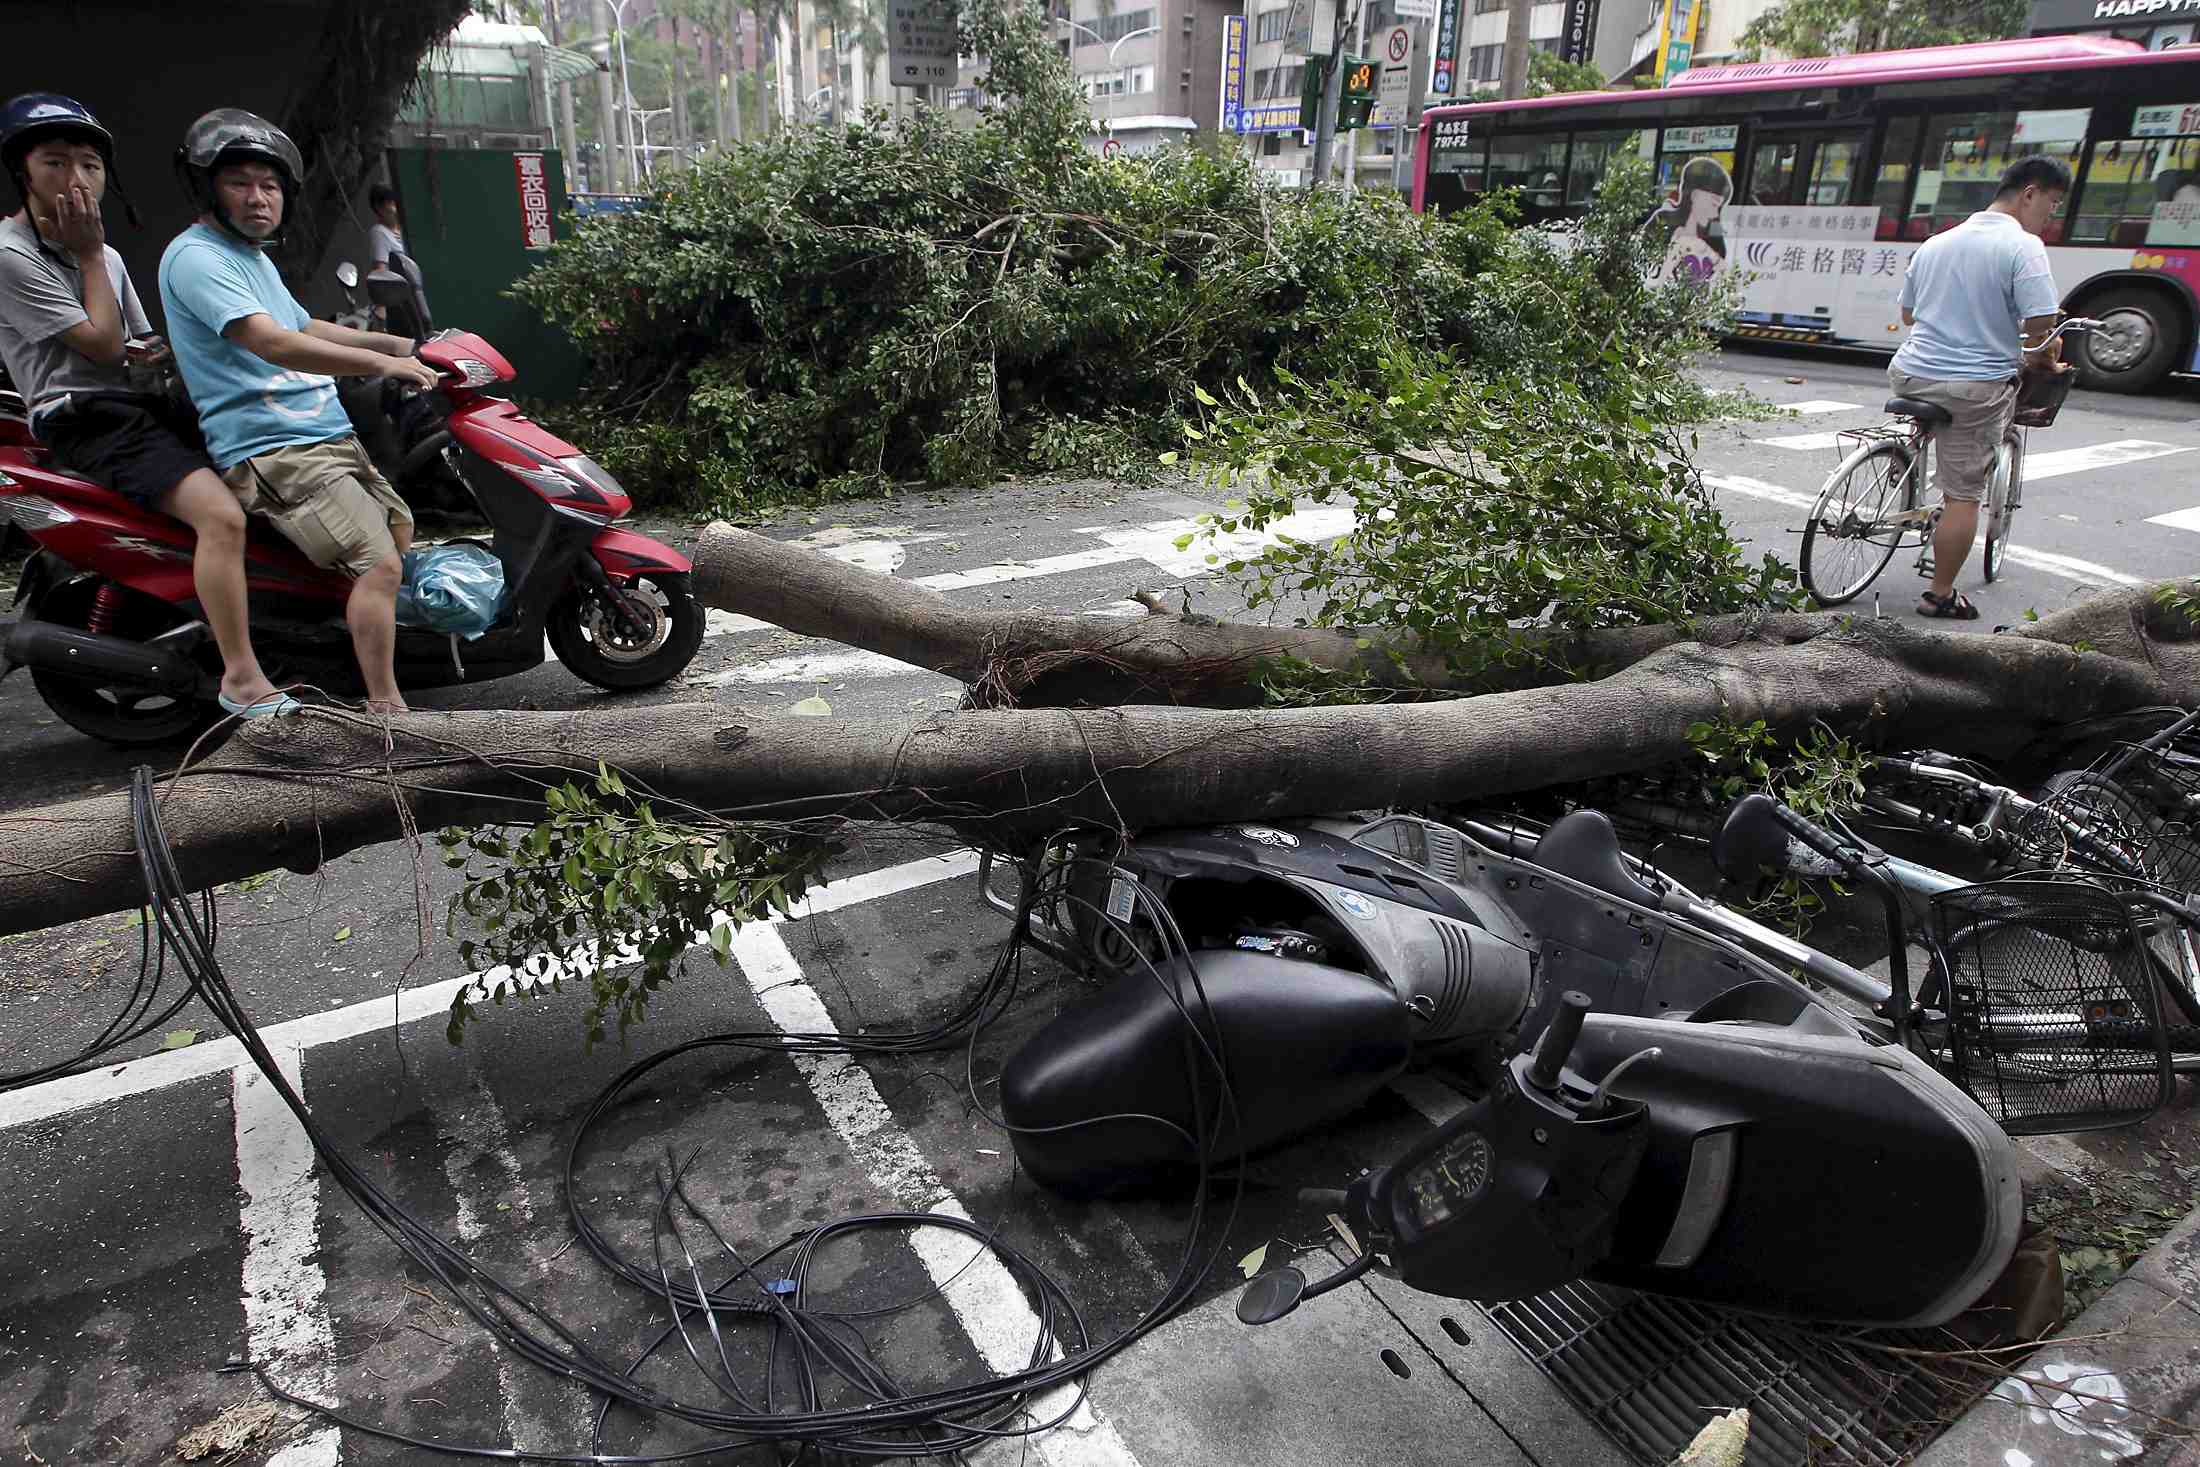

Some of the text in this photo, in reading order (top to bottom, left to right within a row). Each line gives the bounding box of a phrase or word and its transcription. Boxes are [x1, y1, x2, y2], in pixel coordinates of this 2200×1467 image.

[925, 65, 945, 77] 110
[1226, 103, 1237, 113] 2F
[1780, 246, 1908, 277] 維格醫美
